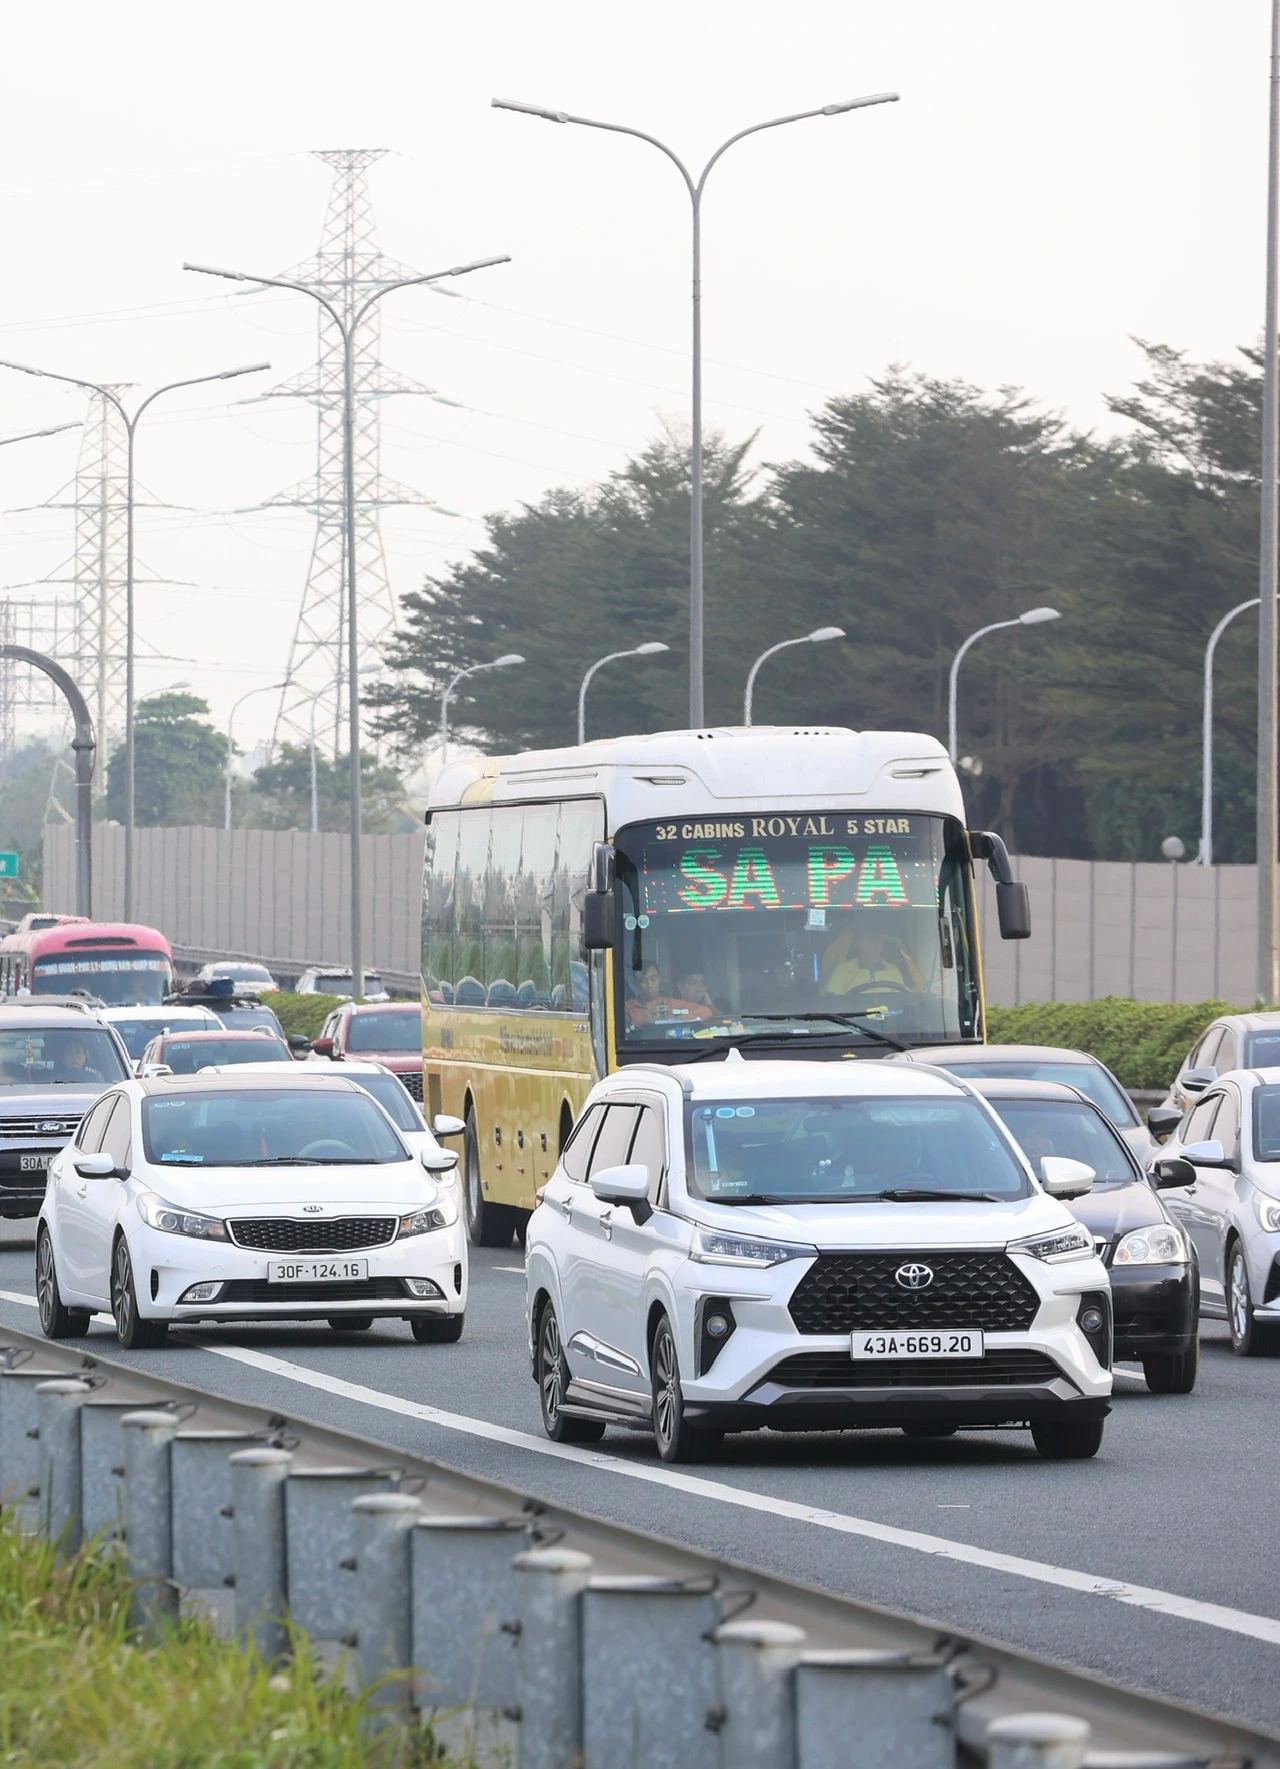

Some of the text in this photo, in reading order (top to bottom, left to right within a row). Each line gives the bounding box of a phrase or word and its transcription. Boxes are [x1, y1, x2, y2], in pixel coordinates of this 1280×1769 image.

[656, 822, 745, 840] 32 CABINS
[751, 816, 835, 837] ROYAL
[847, 818, 911, 835] 5 STAR
[677, 844, 909, 907] SA PA
[41, 1121, 60, 1131] Ford
[277, 1263, 359, 1279] 30F-124.16
[863, 1335, 971, 1354] 43A-669.20
